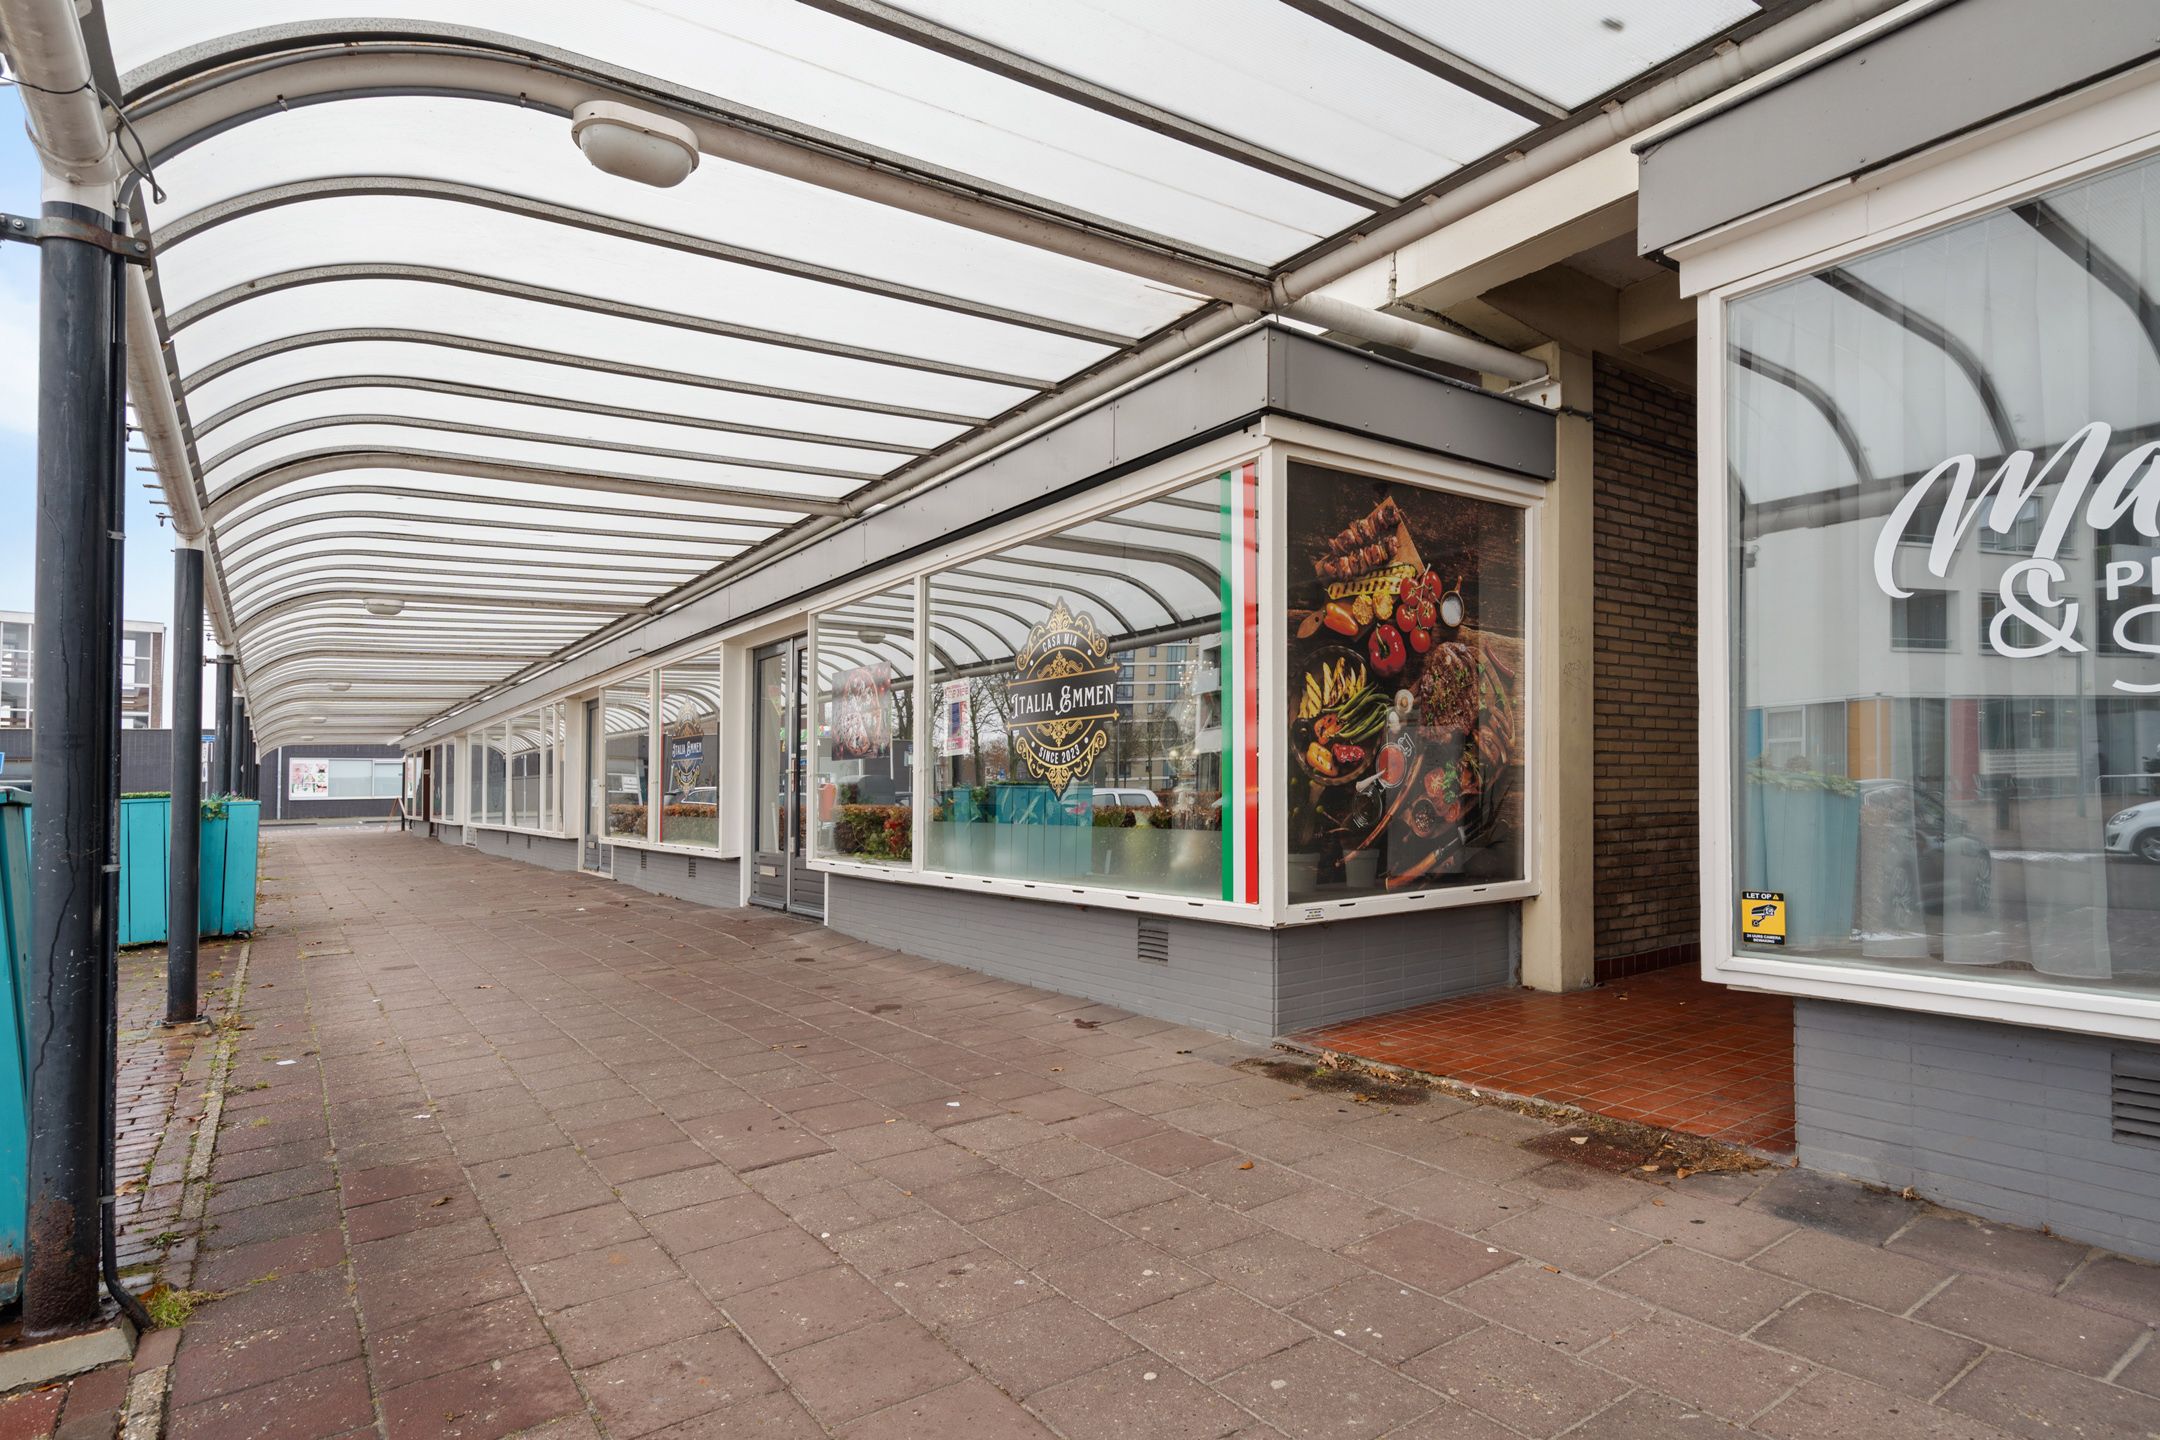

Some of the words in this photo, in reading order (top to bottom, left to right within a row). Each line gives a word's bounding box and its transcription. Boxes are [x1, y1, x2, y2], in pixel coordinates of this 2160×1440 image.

[1989, 558, 2088, 658] &
[1042, 634, 1060, 653] CASA
[1064, 633, 1078, 647] MIA
[1011, 692, 1054, 719] ITALIA
[1055, 684, 1114, 716] EMMEN
[1038, 746, 1059, 764] SINCE
[1061, 744, 1080, 761] 2023
